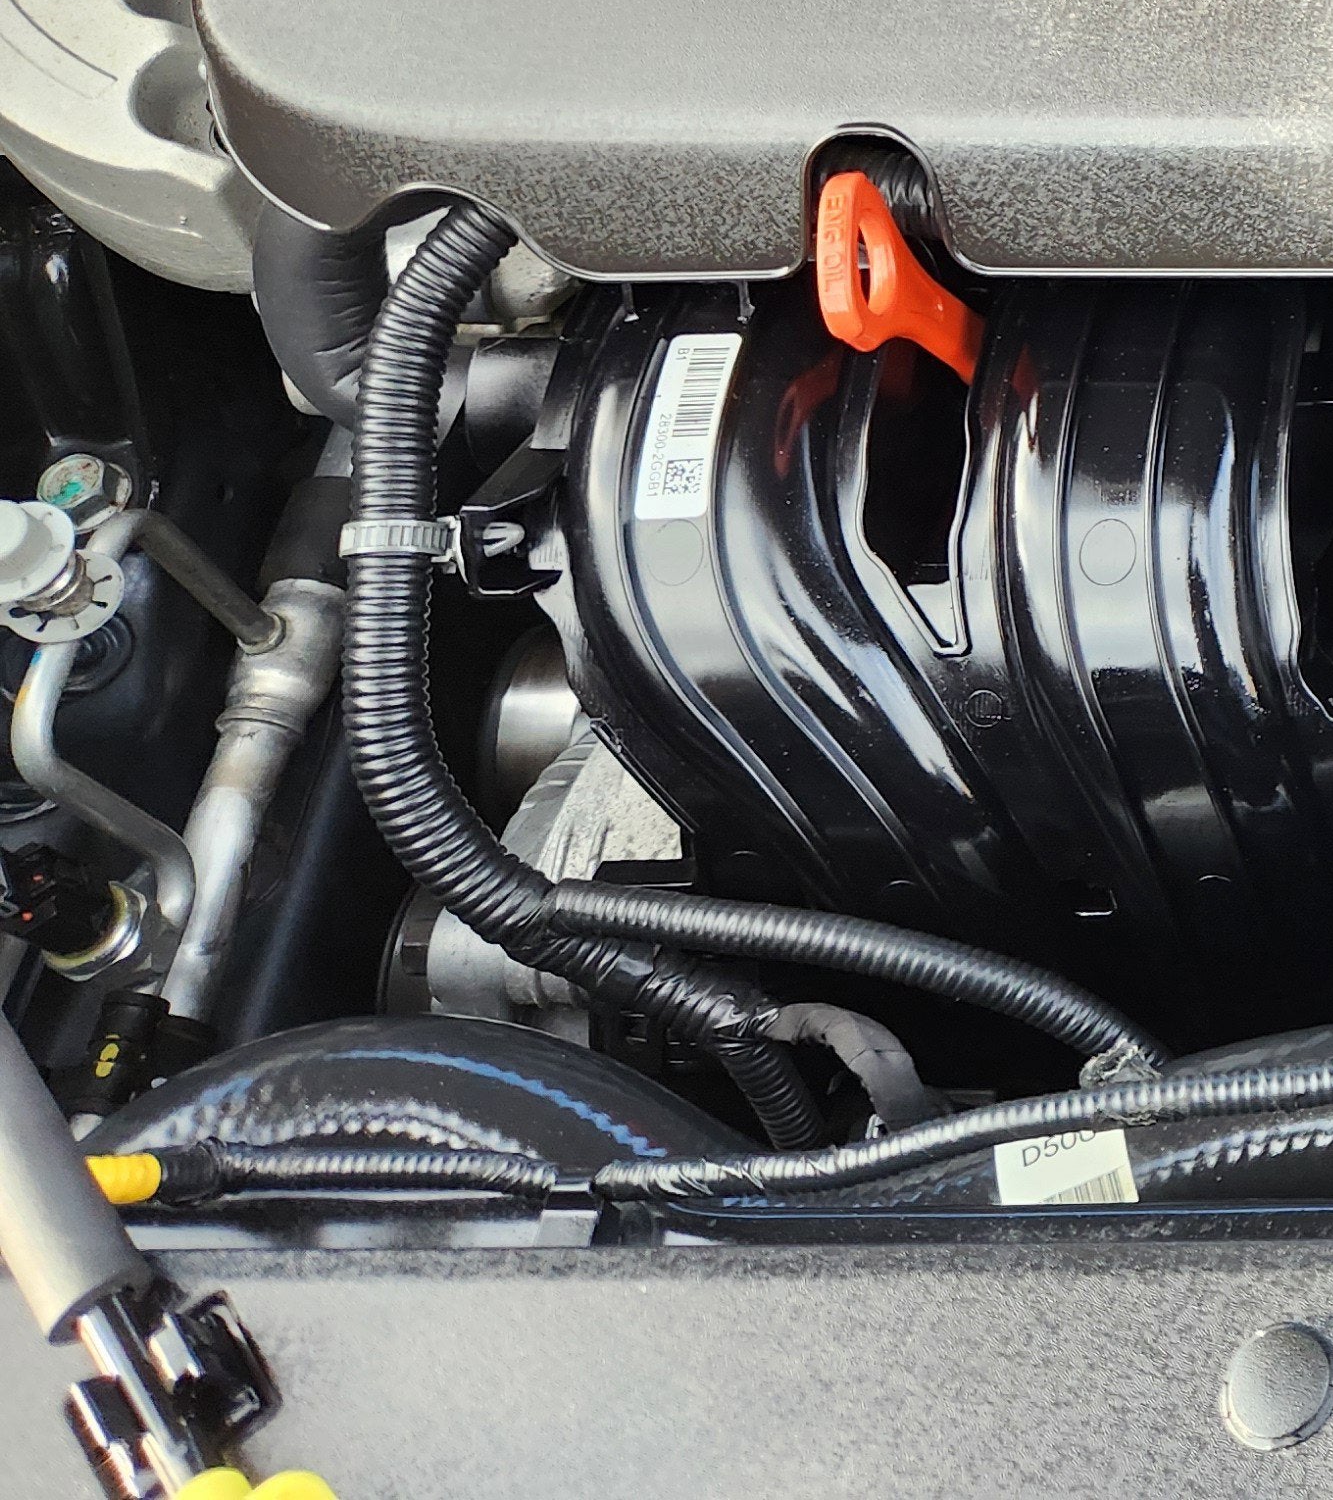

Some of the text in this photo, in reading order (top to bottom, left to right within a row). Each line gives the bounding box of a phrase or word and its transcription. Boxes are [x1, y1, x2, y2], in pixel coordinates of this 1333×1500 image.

[823, 194, 846, 293] ENG OIL
[676, 347, 690, 361] B1
